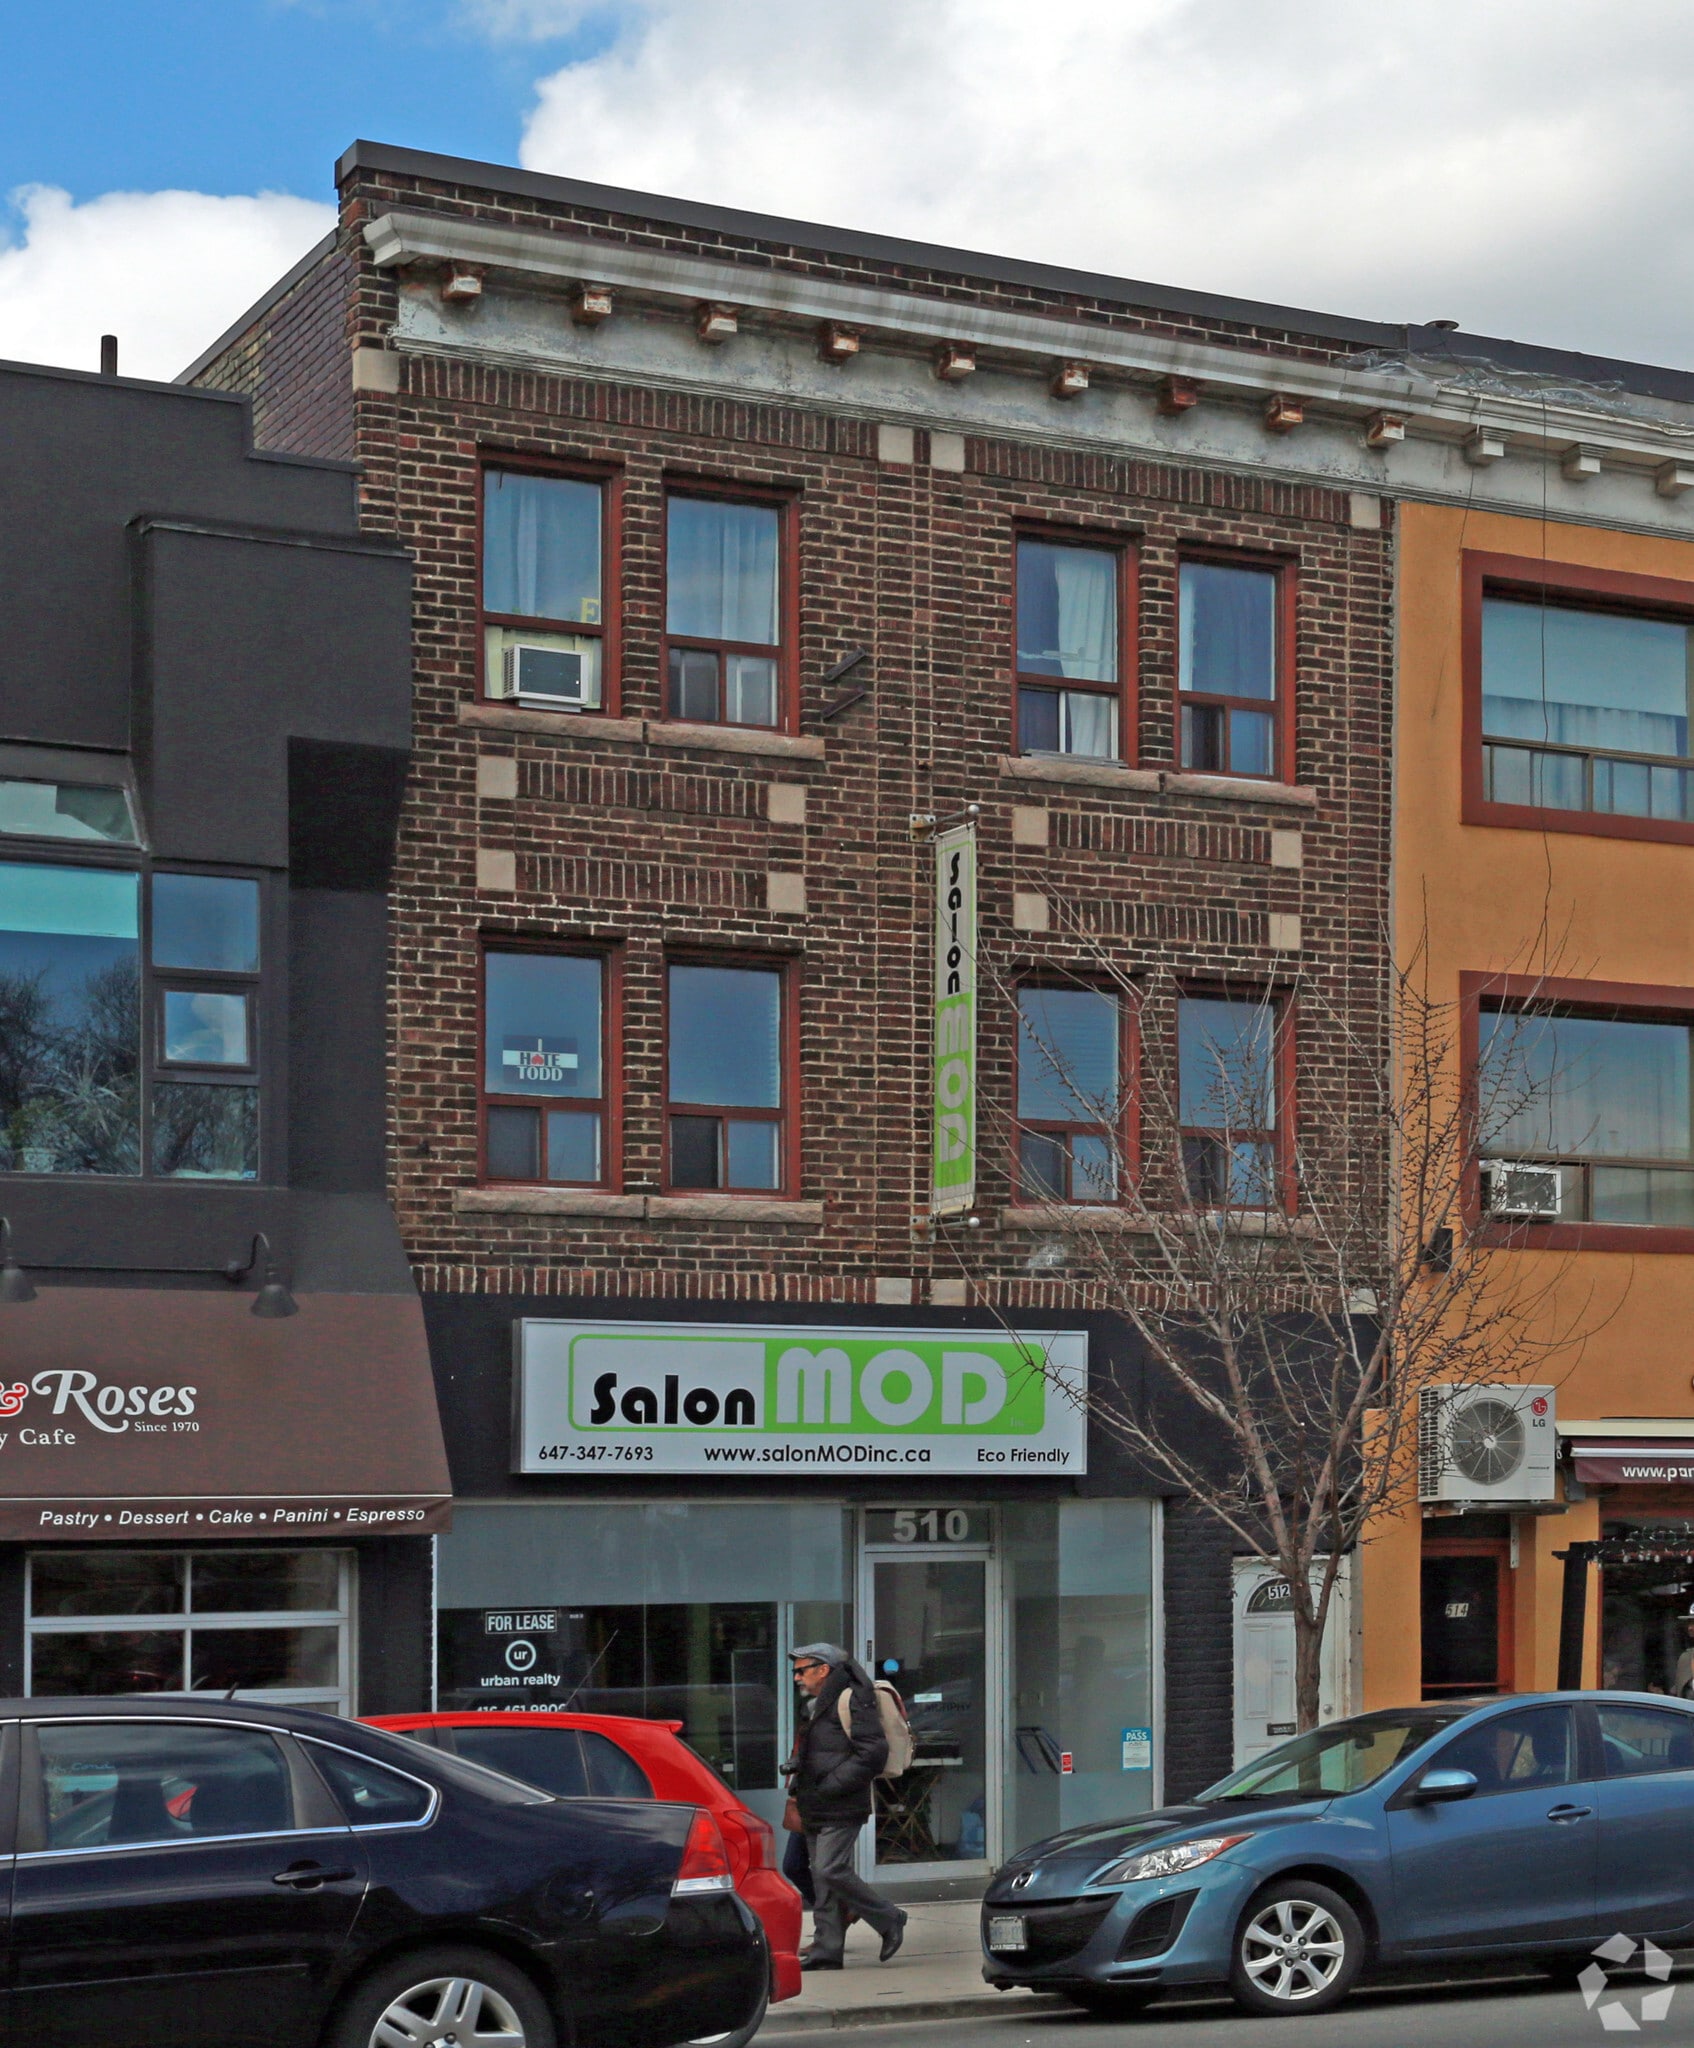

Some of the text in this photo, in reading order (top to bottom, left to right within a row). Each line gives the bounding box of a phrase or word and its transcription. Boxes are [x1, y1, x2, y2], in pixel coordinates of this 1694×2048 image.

[947, 852, 962, 995] Salon
[517, 1066, 563, 1081] TODD
[938, 1003, 969, 1163] MOD
[776, 1347, 1008, 1426] MOD
[31, 1370, 198, 1433] Roses
[590, 1372, 755, 1425] Salon
[134, 1421, 200, 1432] Since 1970
[1532, 1418, 1546, 1428] LG
[19, 1428, 77, 1445] Cafe
[538, 1445, 1070, 1465] 647-347-7693 www.salonMODinc.ca Eco Friendly
[39, 1508, 425, 1528] Pastry Dessert Cake Panini Espresso
[893, 1509, 969, 1542] 510
[1269, 1585, 1290, 1598] 512
[1446, 1603, 1467, 1616] 514
[488, 1614, 555, 1631] FOR LEASE
[513, 1651, 528, 1660] ur
[481, 1673, 561, 1687] urban realty
[1126, 1732, 1147, 1741] PASS
